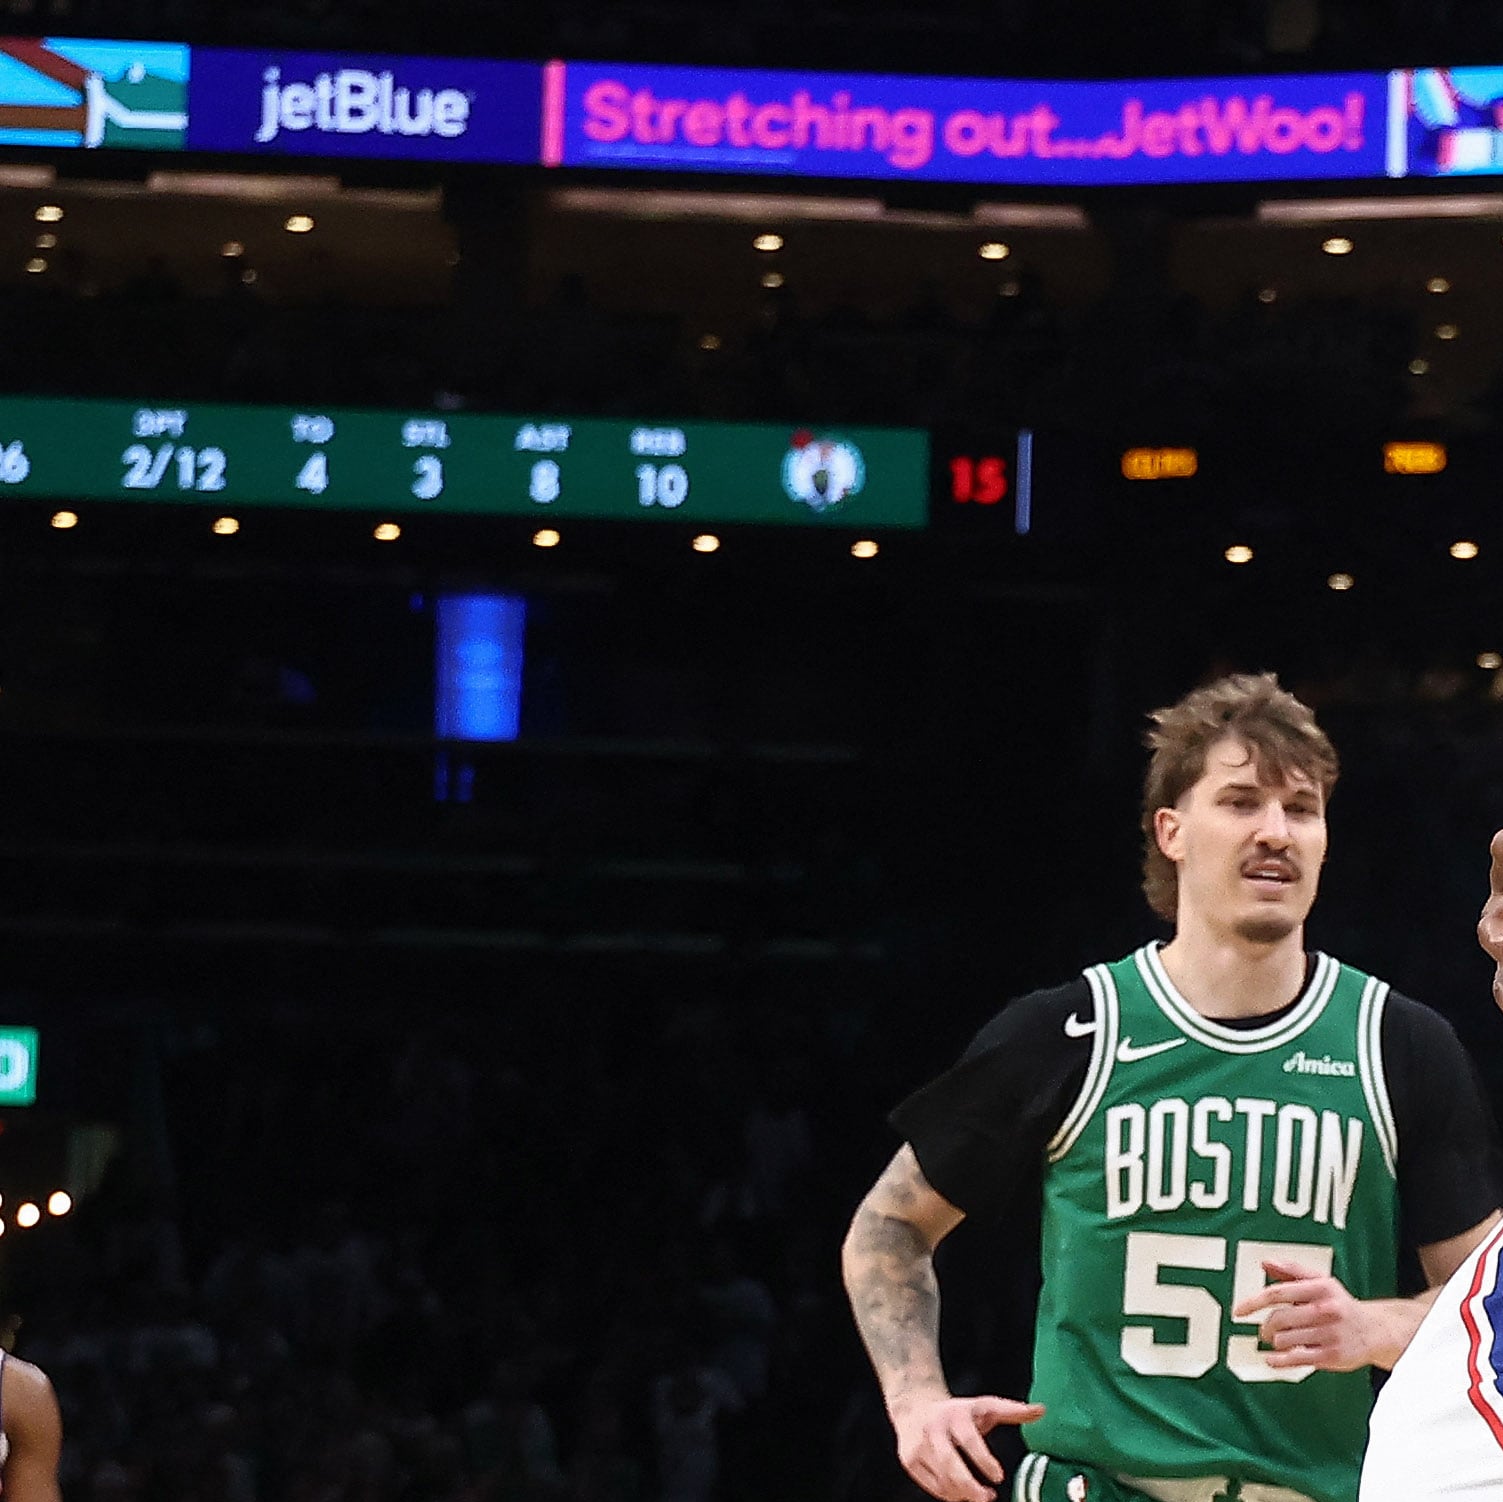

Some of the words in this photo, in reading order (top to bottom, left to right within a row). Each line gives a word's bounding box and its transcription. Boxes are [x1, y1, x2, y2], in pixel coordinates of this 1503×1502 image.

[255, 66, 471, 144] jetBlue
[582, 79, 934, 170] Stretching
[0, 441, 30, 484] 6
[122, 443, 226, 491] 2/12
[296, 452, 328, 494] 4
[411, 455, 443, 500] 3
[529, 460, 561, 503] 8
[635, 464, 689, 508] 10
[0, 1038, 30, 1091] D
[1283, 1051, 1355, 1077] Amica
[1105, 1097, 1364, 1230] BOSTON
[1120, 1231, 1334, 1383] 55
